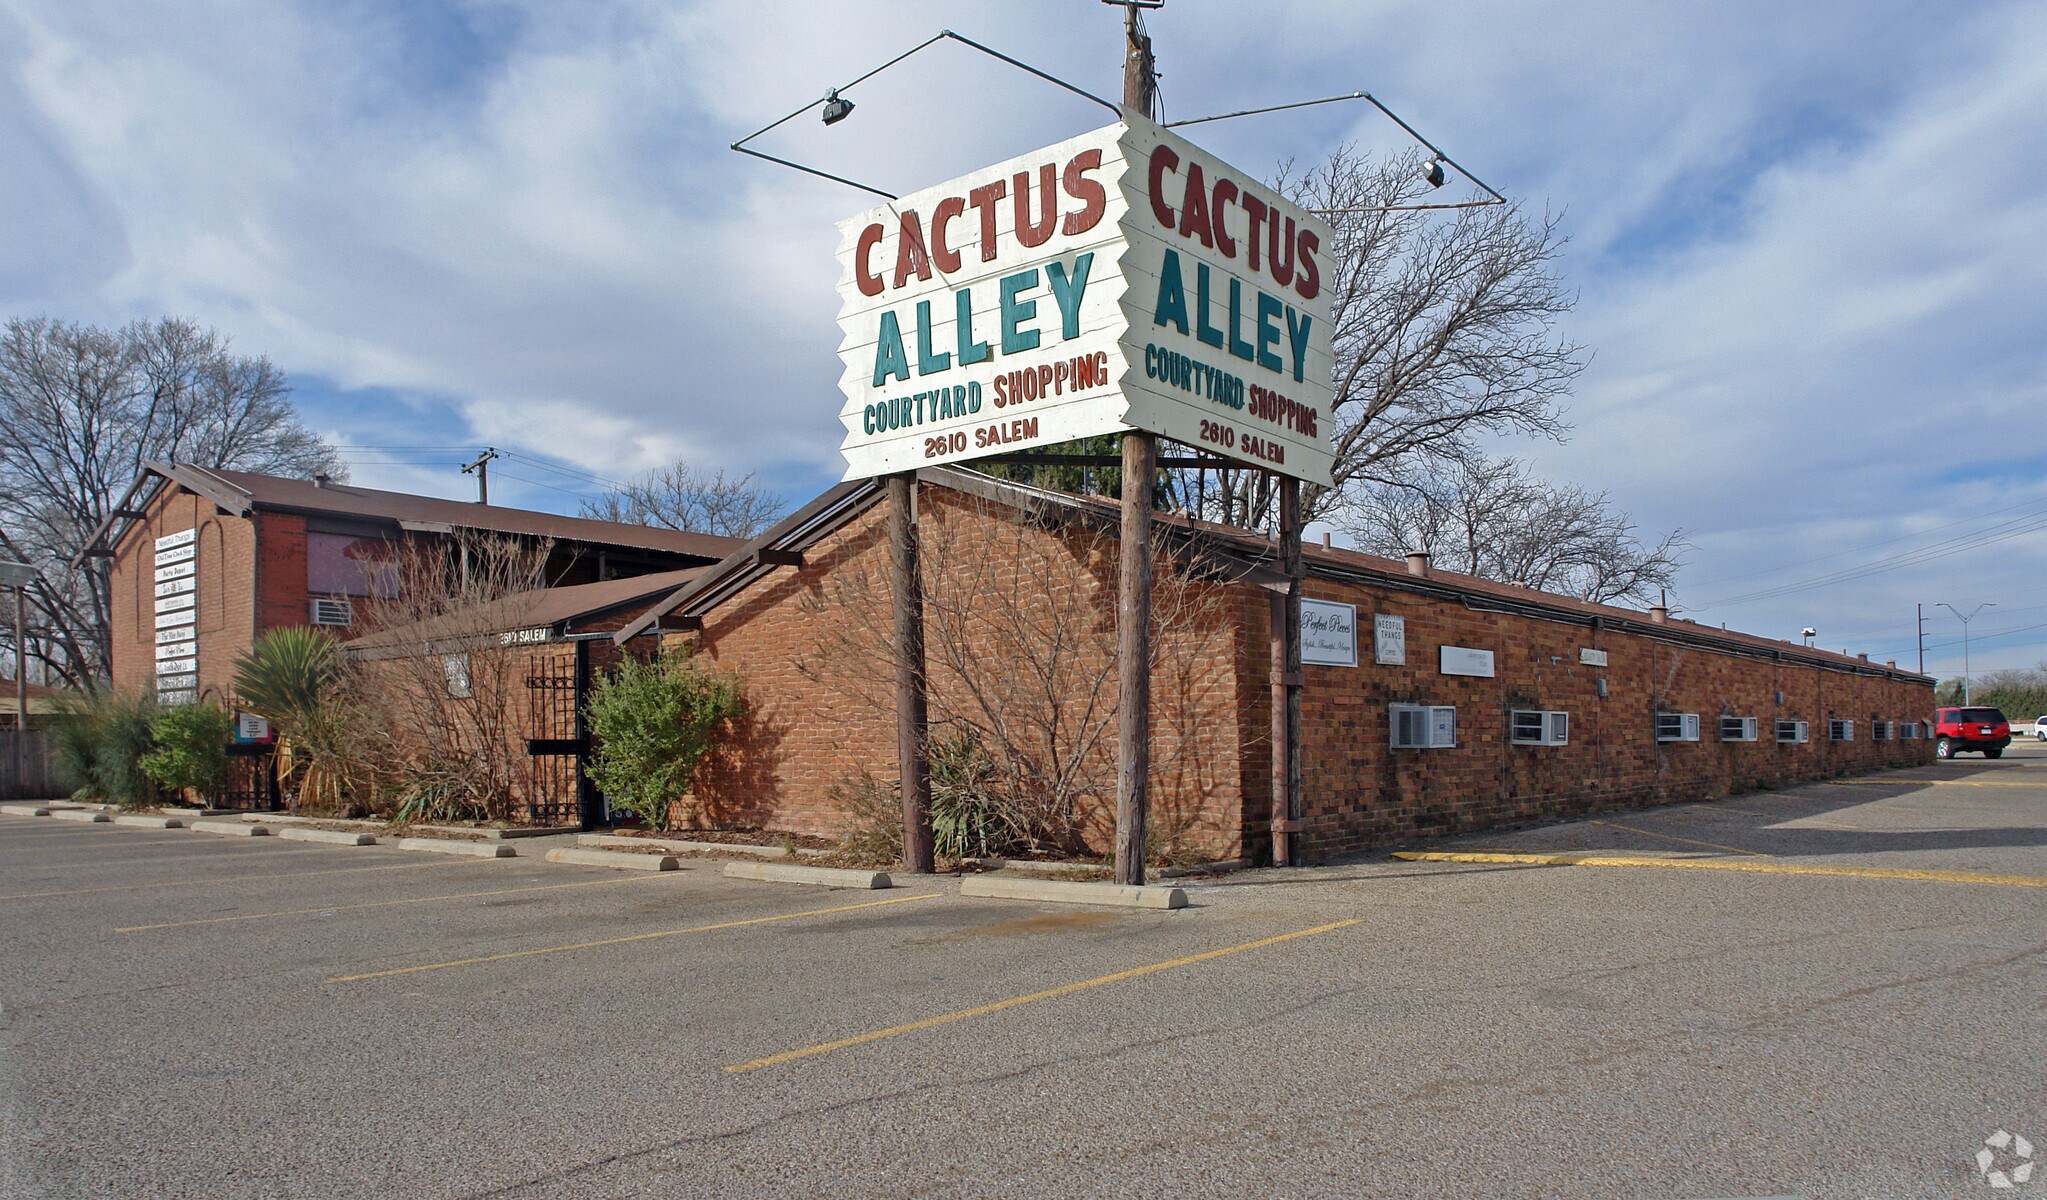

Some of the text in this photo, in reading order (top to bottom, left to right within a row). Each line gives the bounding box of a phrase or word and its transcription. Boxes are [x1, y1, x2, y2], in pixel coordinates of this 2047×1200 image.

[855, 149, 1107, 298] CACTUS
[1148, 144, 1320, 300] CACTUS
[872, 252, 1095, 387] ALLEY
[1154, 248, 1313, 383] ALLEY
[863, 350, 1109, 436] COURTYARD SHOPPING
[1145, 342, 1319, 439] COURTYARD SHOPPING
[924, 416, 1039, 459] 2610 SALEM
[1199, 419, 1286, 466] 2610 SALEM
[519, 628, 546, 643] SALEM
[1300, 611, 1328, 636] Perfect
[1378, 619, 1403, 631] NEEDFUL
[1381, 629, 1402, 640] THANGS
